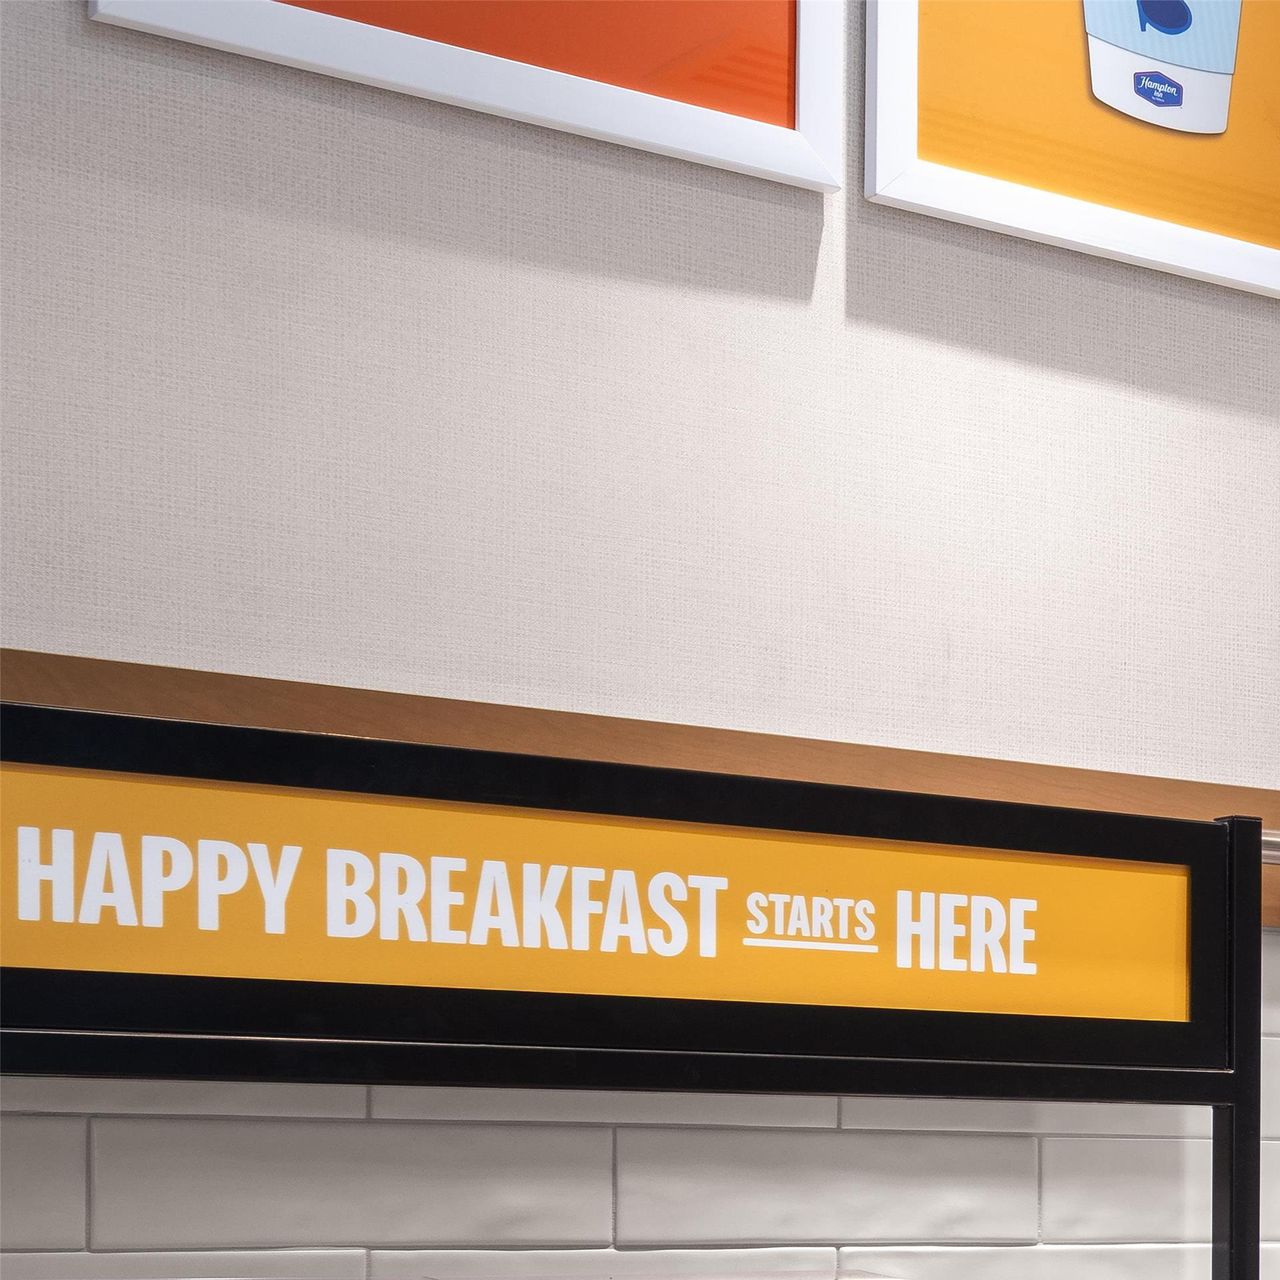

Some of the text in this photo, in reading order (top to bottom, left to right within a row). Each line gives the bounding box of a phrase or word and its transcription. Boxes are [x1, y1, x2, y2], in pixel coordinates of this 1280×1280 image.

[1138, 75, 1179, 97] Hampton
[17, 826, 1038, 975] HAPPY BREAKFAST STARTS HERE
